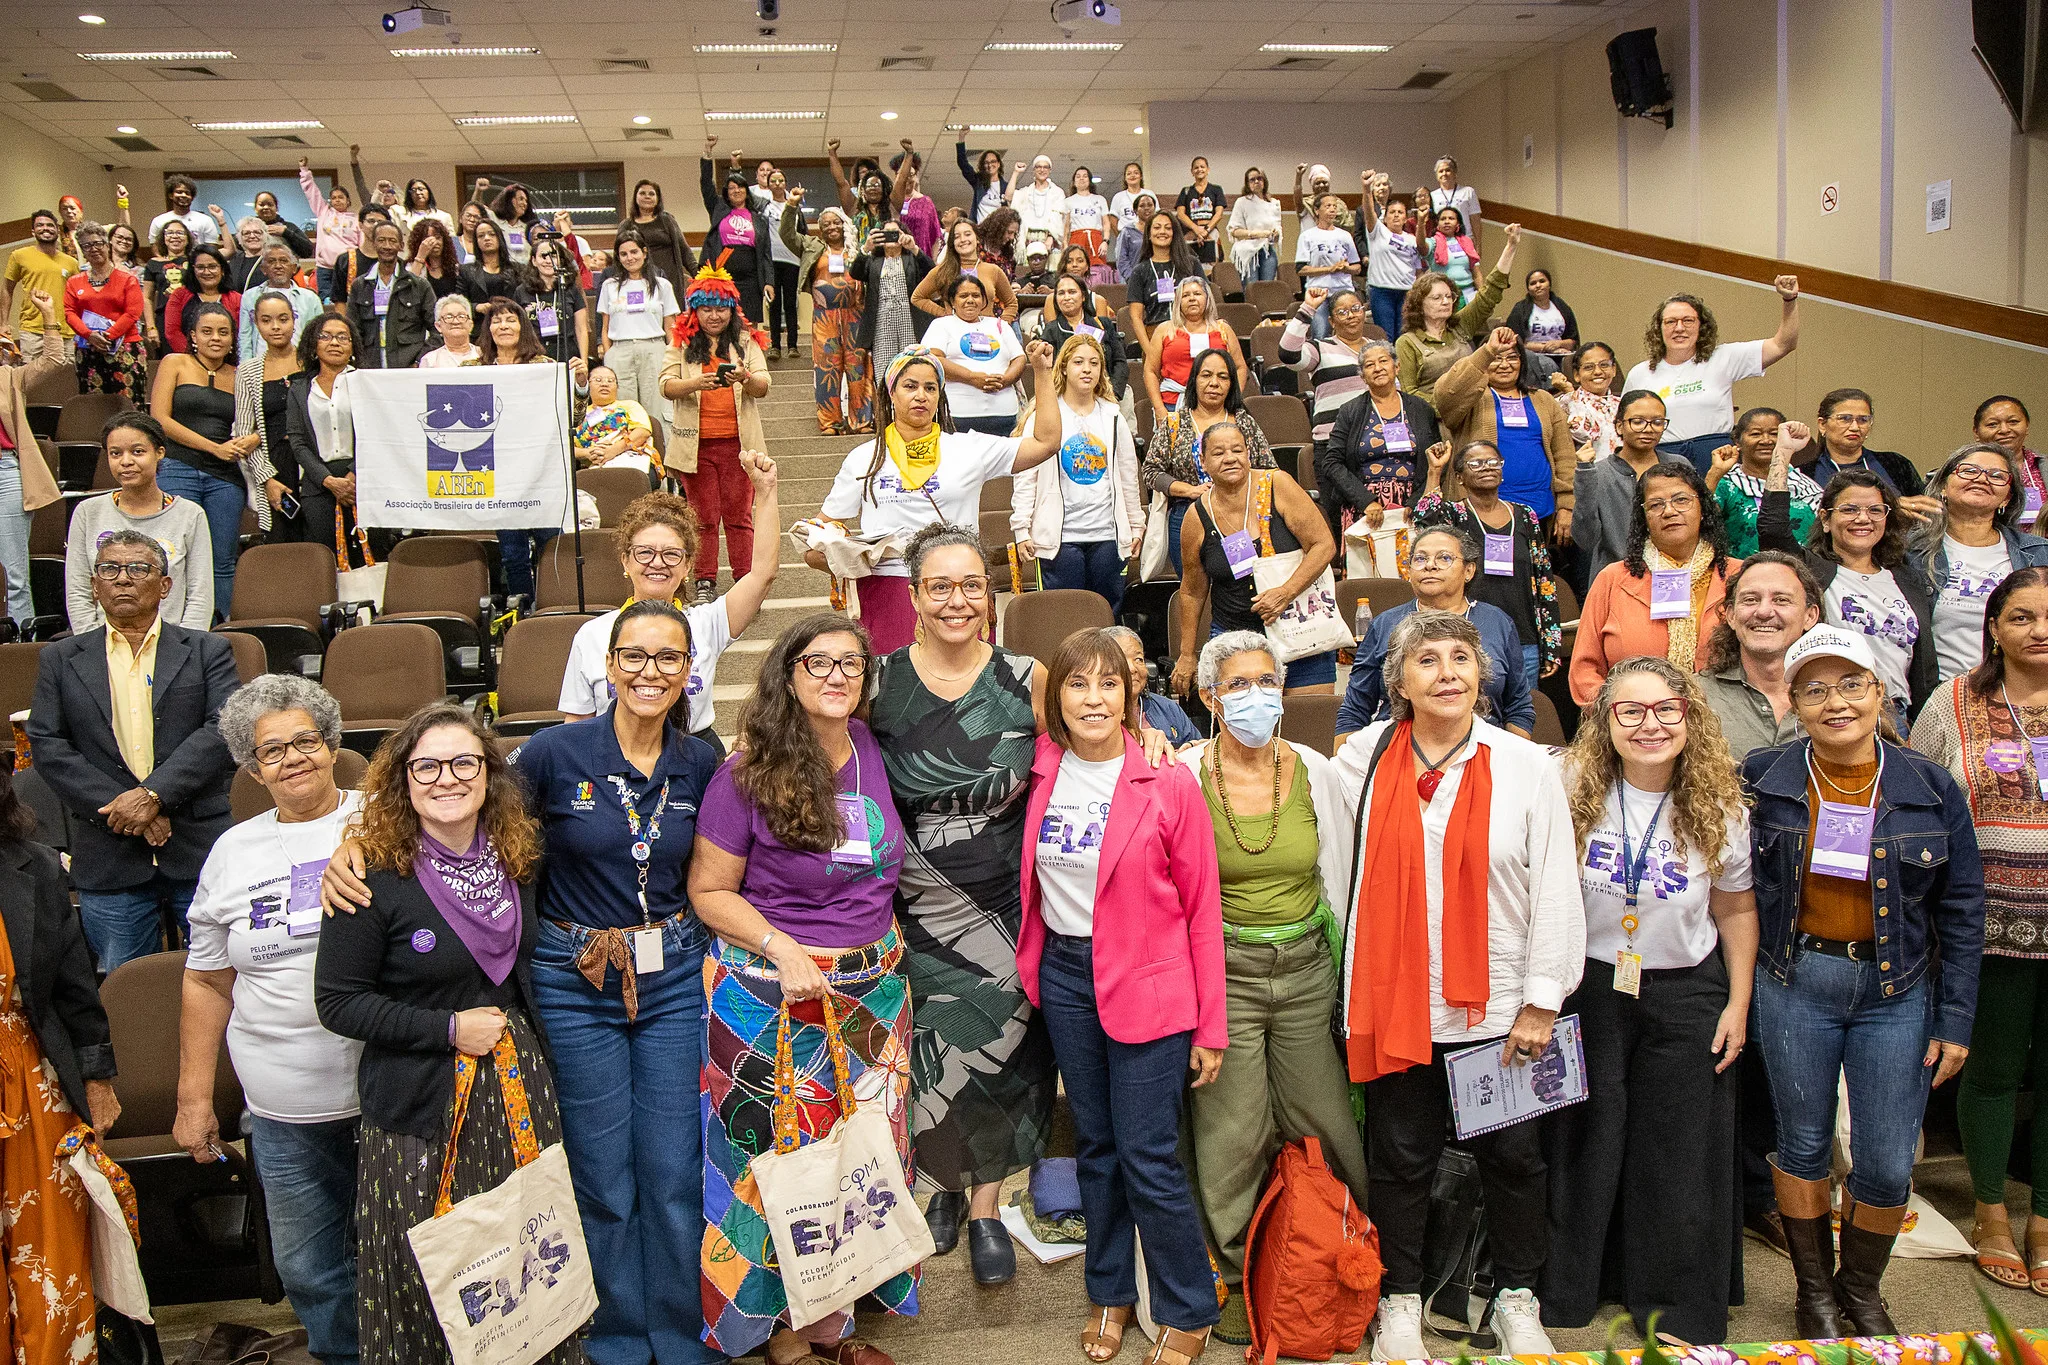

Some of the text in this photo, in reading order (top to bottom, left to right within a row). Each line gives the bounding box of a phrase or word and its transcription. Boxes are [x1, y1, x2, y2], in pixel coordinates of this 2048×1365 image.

[435, 474, 486, 496] ABEn
[385, 499, 541, 511] Associação Brasileira de Enfermagem
[1039, 814, 1103, 854] ELA
[248, 875, 291, 892] COLABORATÓRIO
[250, 943, 279, 953] PELO FIM
[262, 947, 302, 960] FEMINICÍDIO
[790, 1178, 898, 1257] ELAS
[458, 1229, 570, 1327] ELAS
